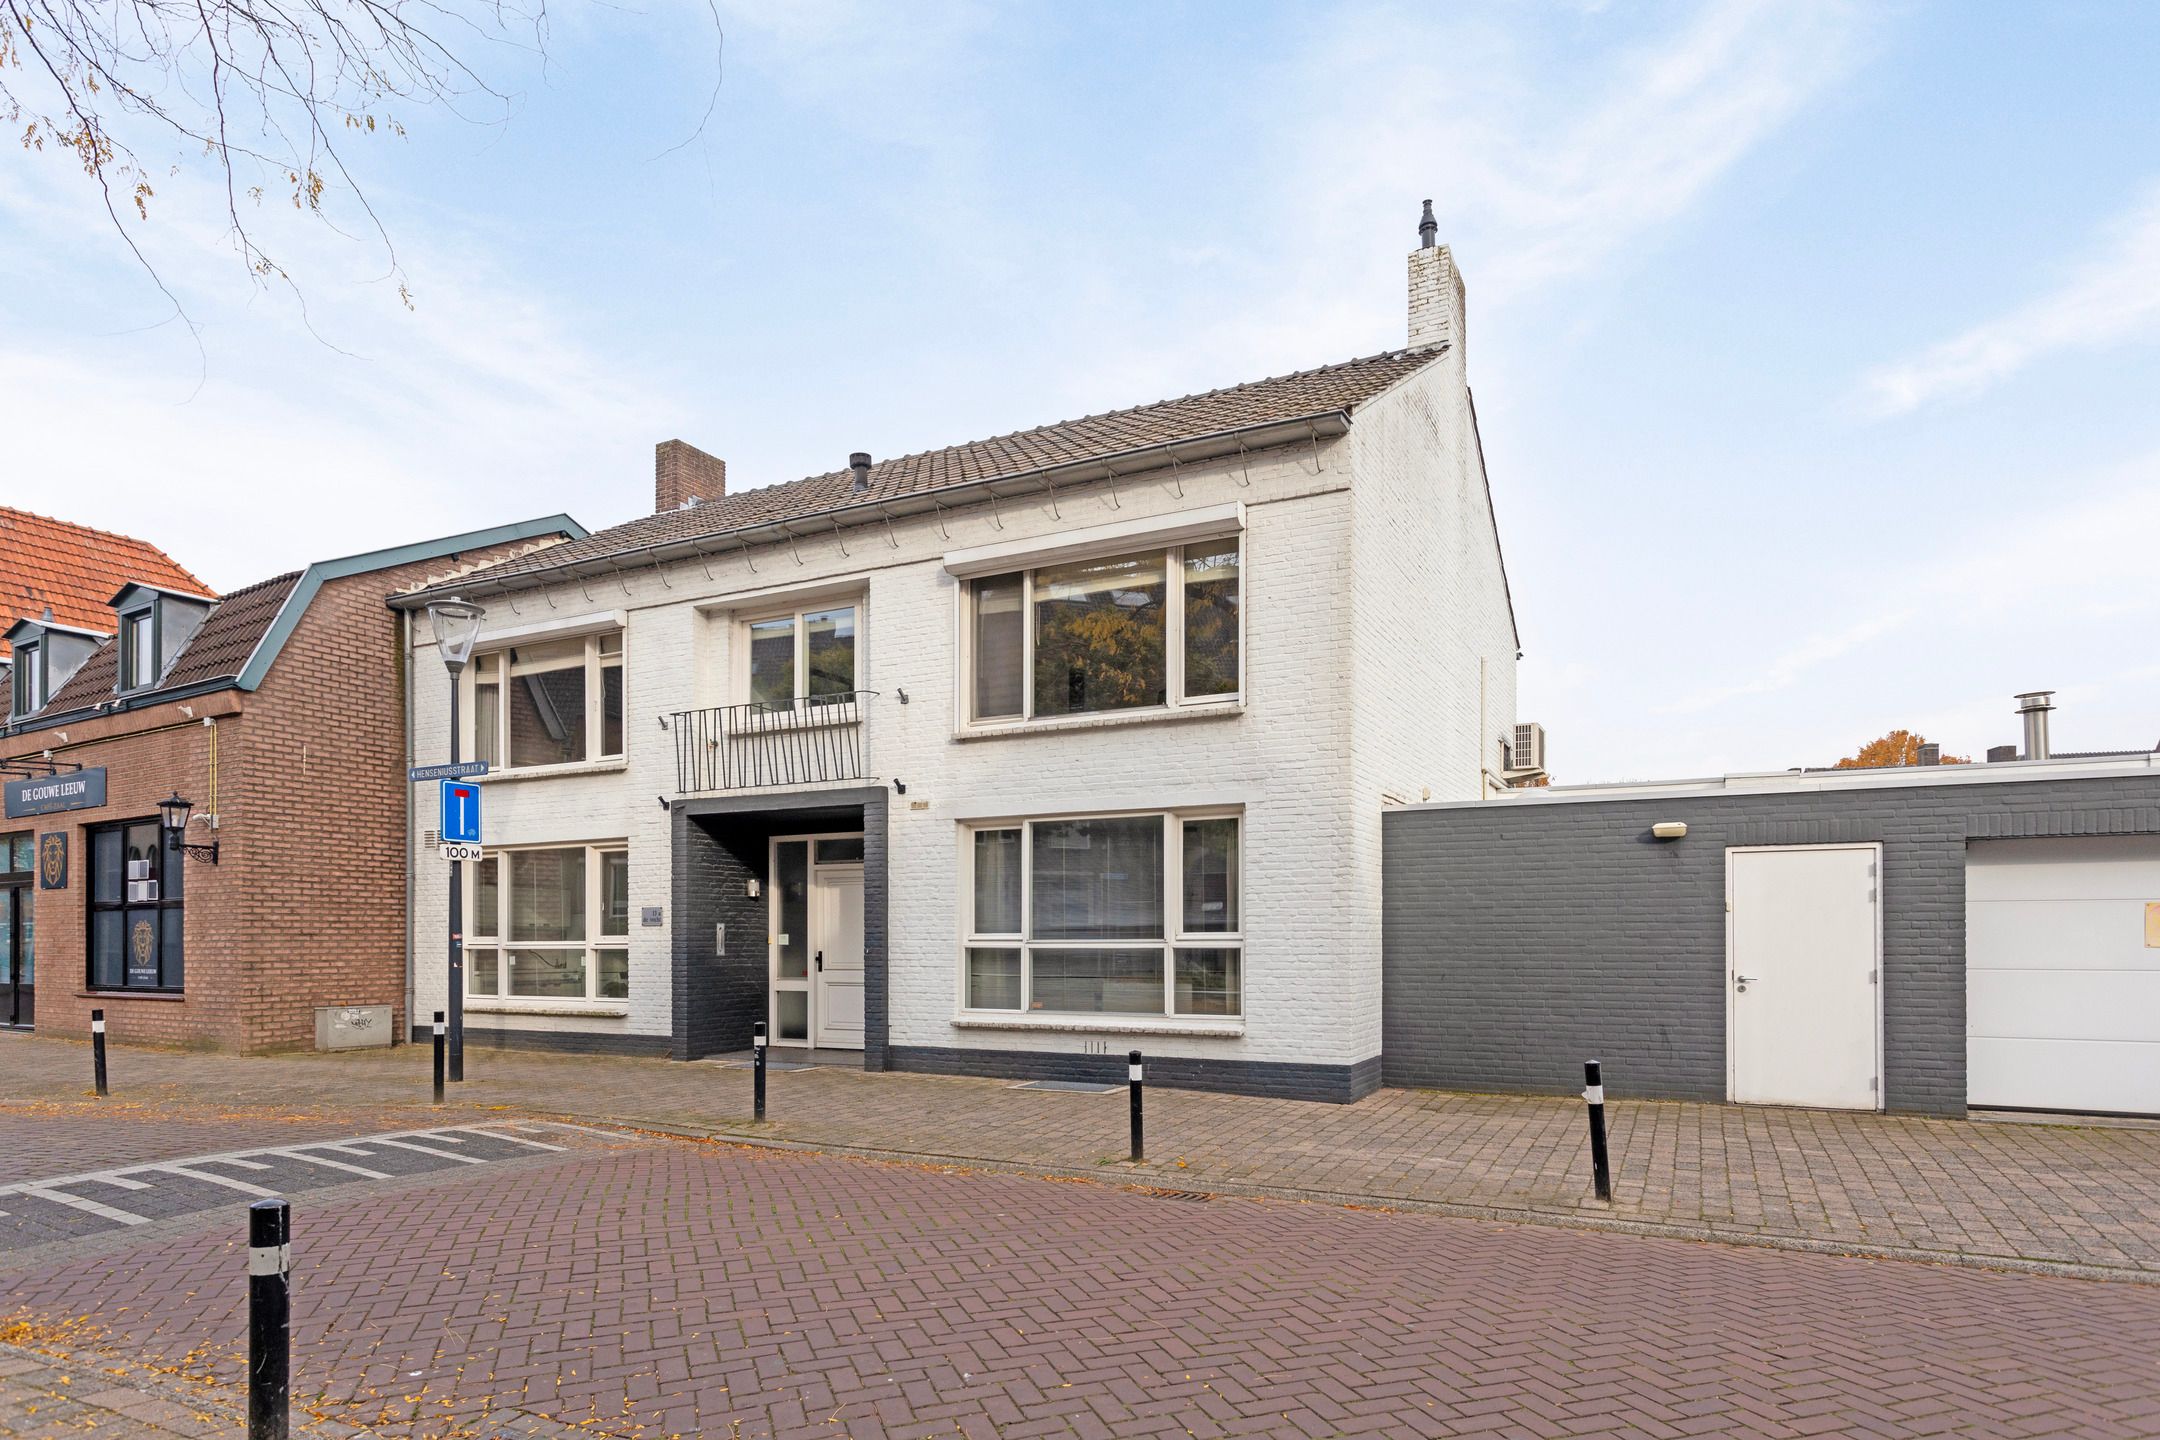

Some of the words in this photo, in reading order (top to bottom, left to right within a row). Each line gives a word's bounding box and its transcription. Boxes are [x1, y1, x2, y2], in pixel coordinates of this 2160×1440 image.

[416, 764, 478, 778] HENSENIUSSTRAAT
[22, 789, 32, 802] DE
[33, 785, 60, 801] GOUWE
[61, 780, 86, 796] LEEUW
[445, 847, 469, 859] 100
[471, 850, 480, 859] M
